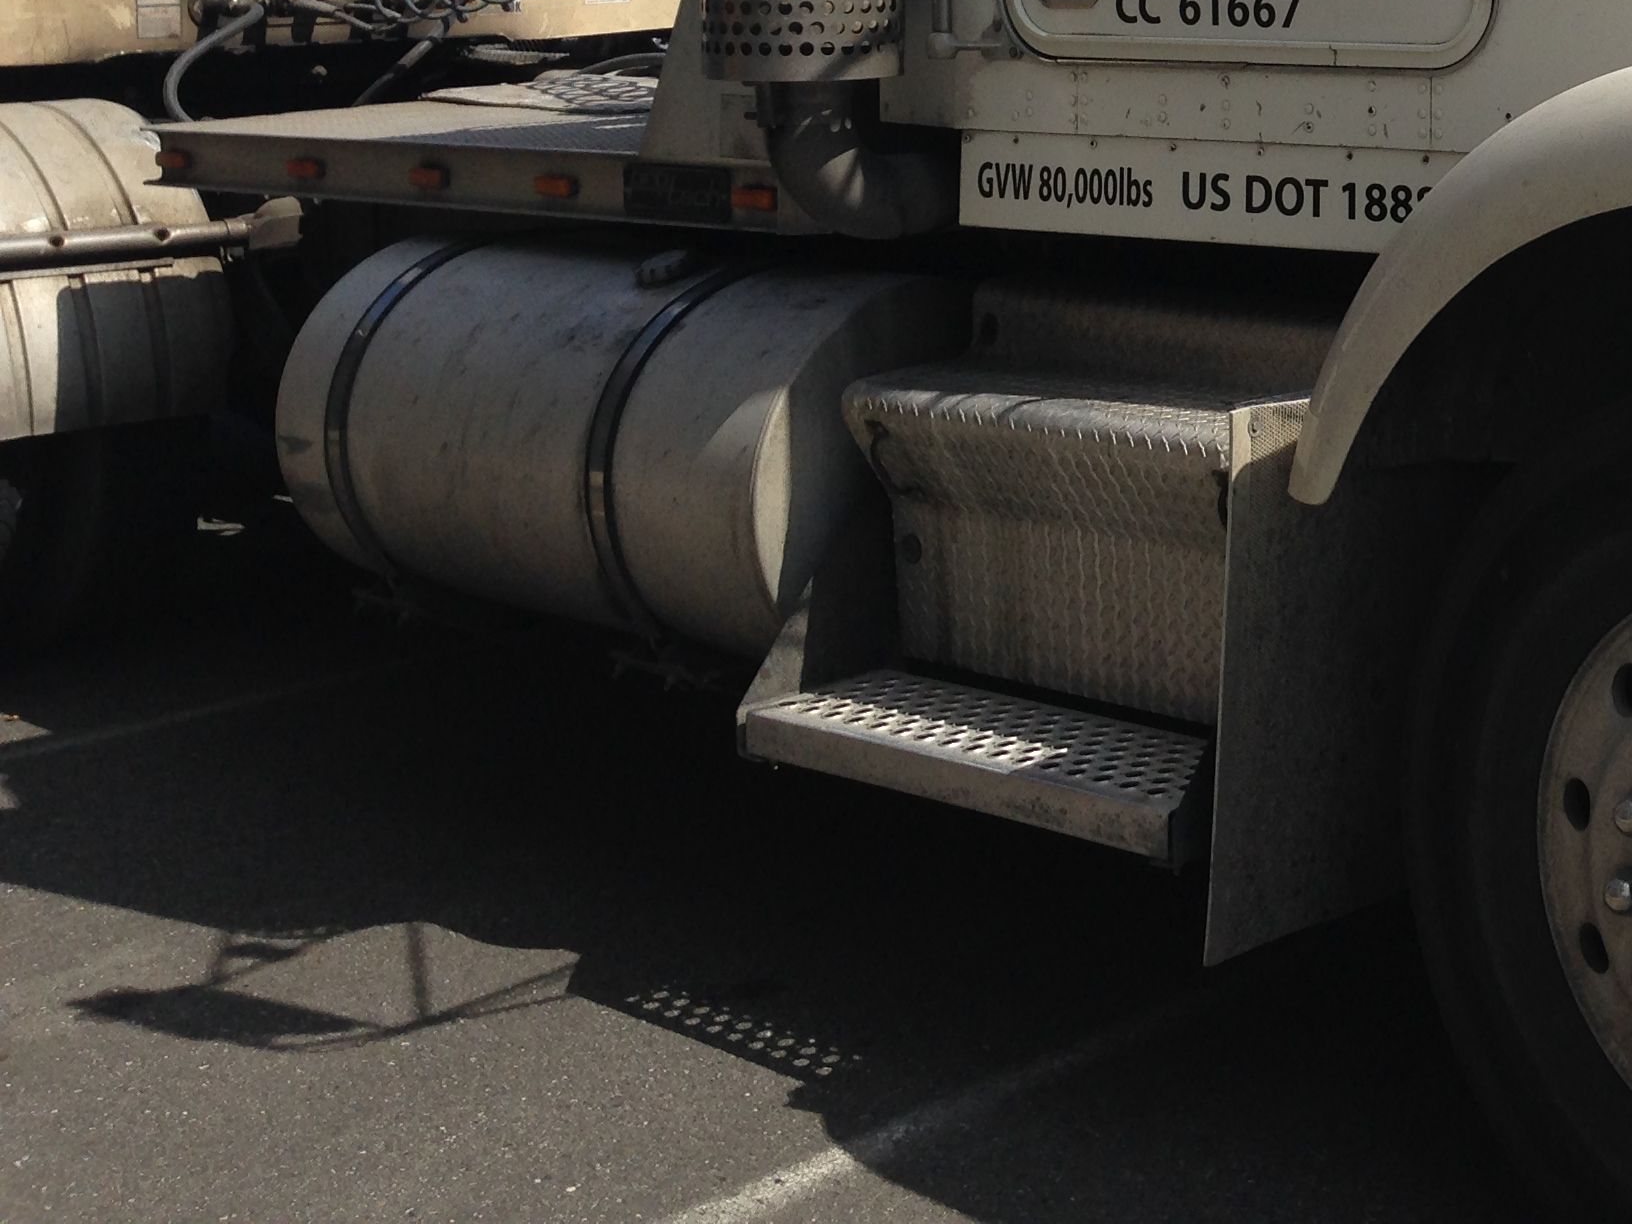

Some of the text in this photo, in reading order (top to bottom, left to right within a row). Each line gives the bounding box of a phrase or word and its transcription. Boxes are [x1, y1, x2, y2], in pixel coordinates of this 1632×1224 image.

[978, 161, 1153, 209] GVW 80,000lbs
[1182, 171, 1231, 212] US
[1245, 175, 1329, 218] DOT
